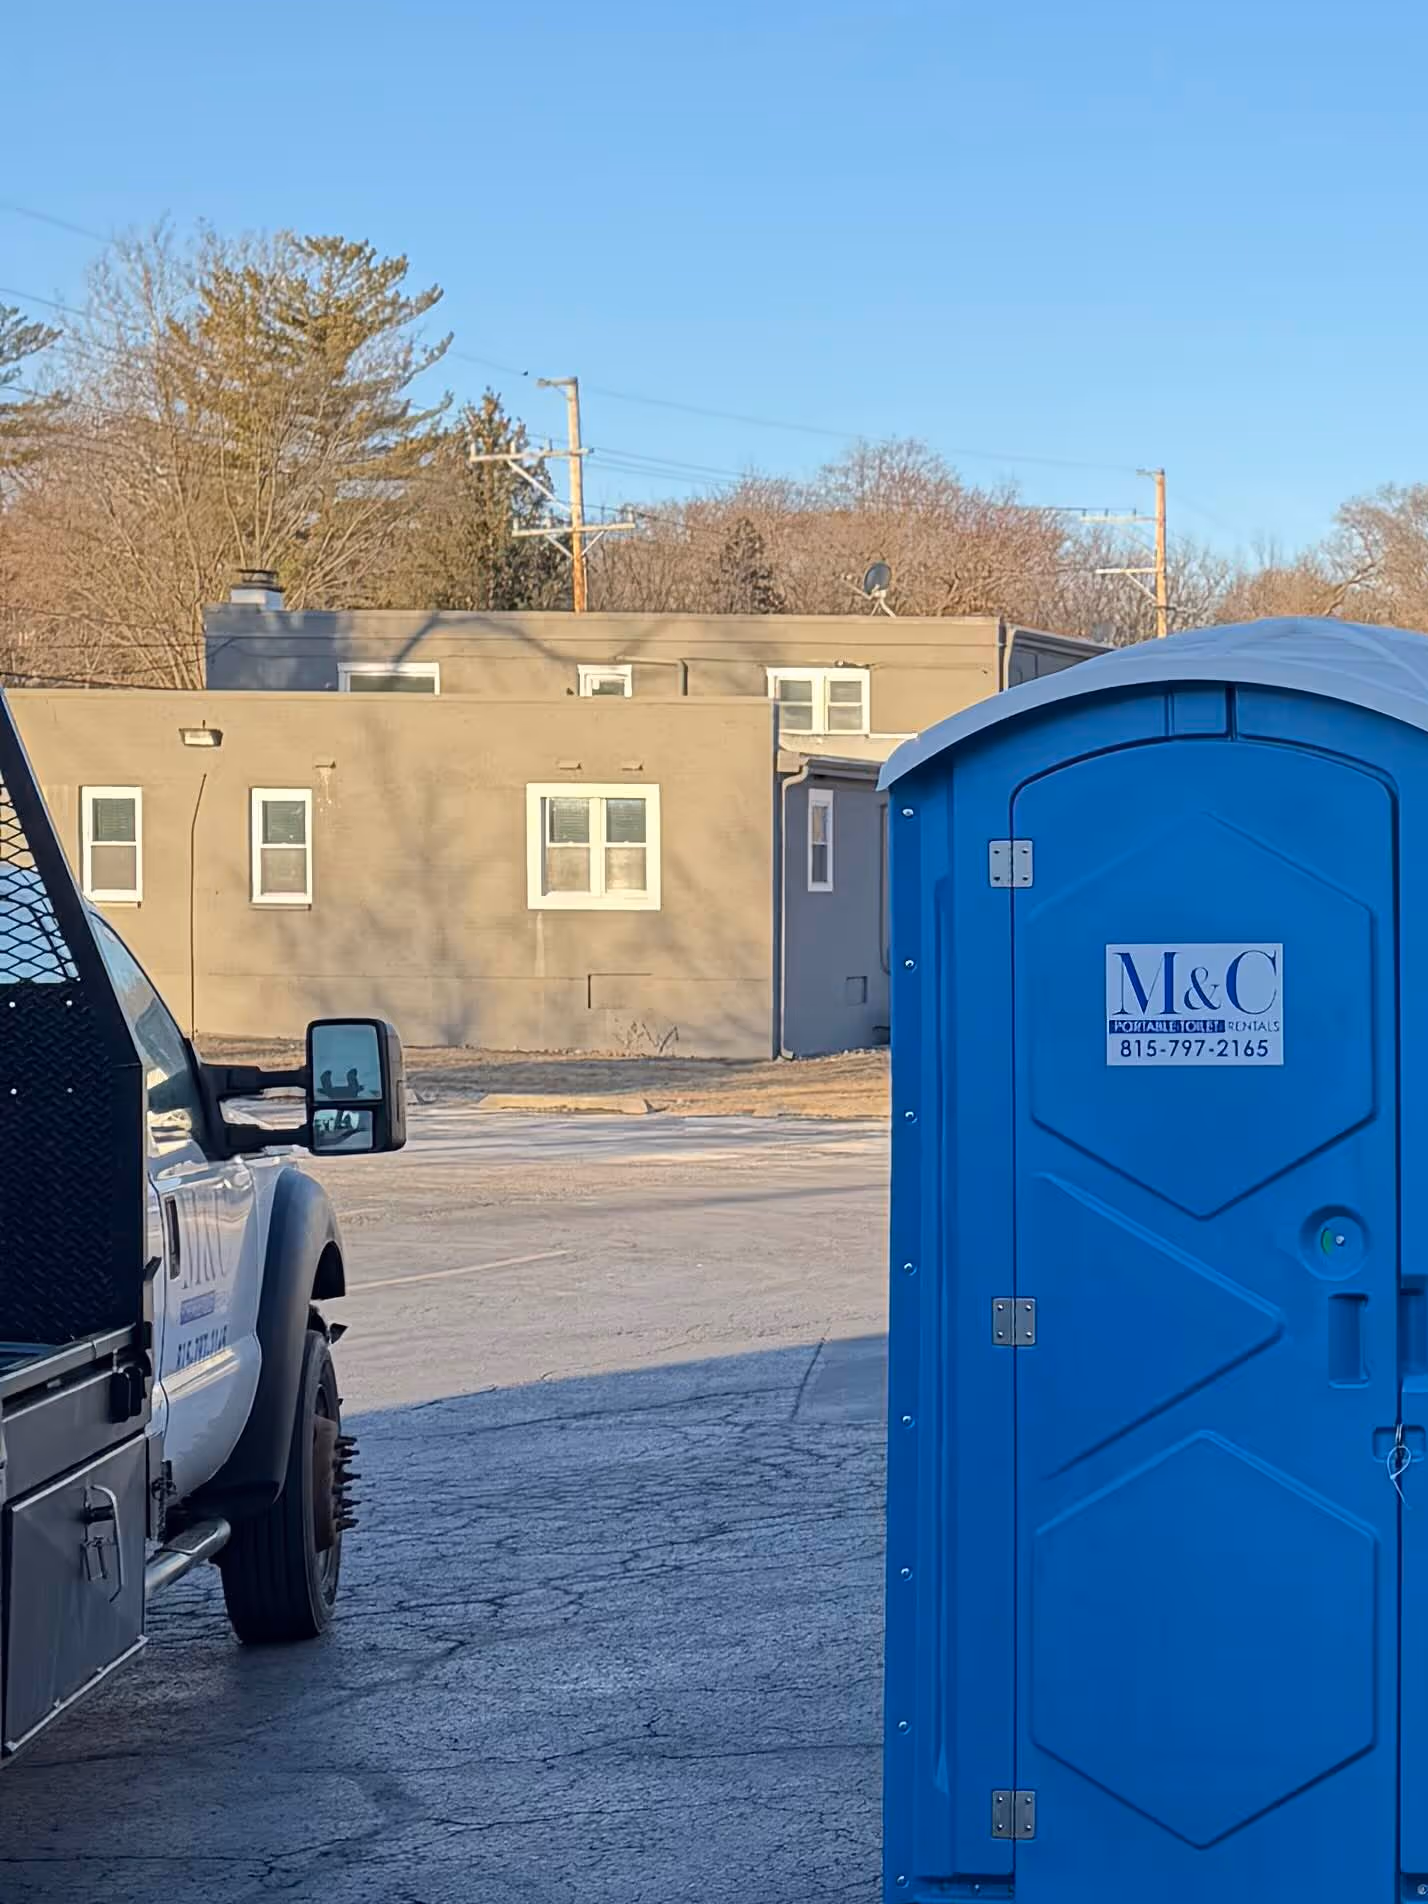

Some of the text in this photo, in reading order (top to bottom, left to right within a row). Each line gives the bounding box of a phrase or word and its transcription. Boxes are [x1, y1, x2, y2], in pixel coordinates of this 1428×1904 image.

[1112, 949, 1277, 1015] M&C
[1228, 1021, 1280, 1033] RENTALS
[1120, 1039, 1269, 1058] 815-797-2165
